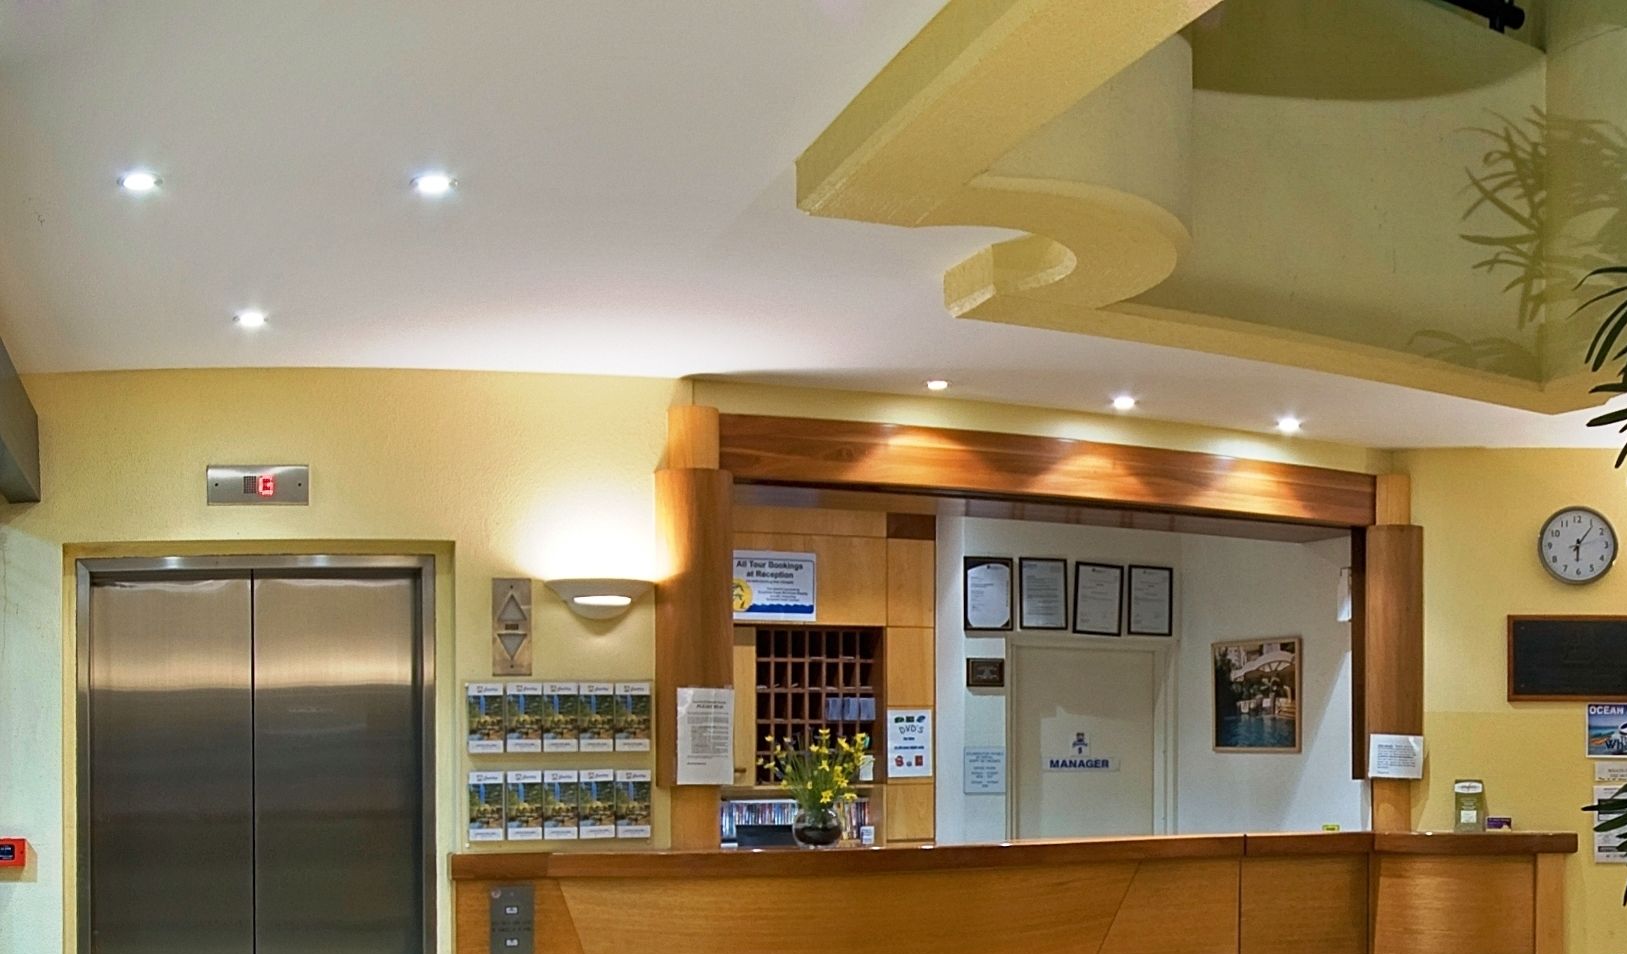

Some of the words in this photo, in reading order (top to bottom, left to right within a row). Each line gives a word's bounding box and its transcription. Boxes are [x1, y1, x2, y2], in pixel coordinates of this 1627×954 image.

[1573, 515, 1582, 523] 12
[1561, 520, 1568, 528] 11
[1551, 529, 1560, 537] 10
[1604, 541, 1609, 549] 3
[1552, 555, 1557, 563] 8
[736, 560, 747, 568] All
[768, 561, 803, 571] Bookings
[1563, 564, 1568, 572] 7
[1589, 564, 1594, 572] 5
[756, 571, 794, 579] Reception
[1589, 705, 1624, 715] OCEAN
[1049, 759, 1109, 768] MANAGER
